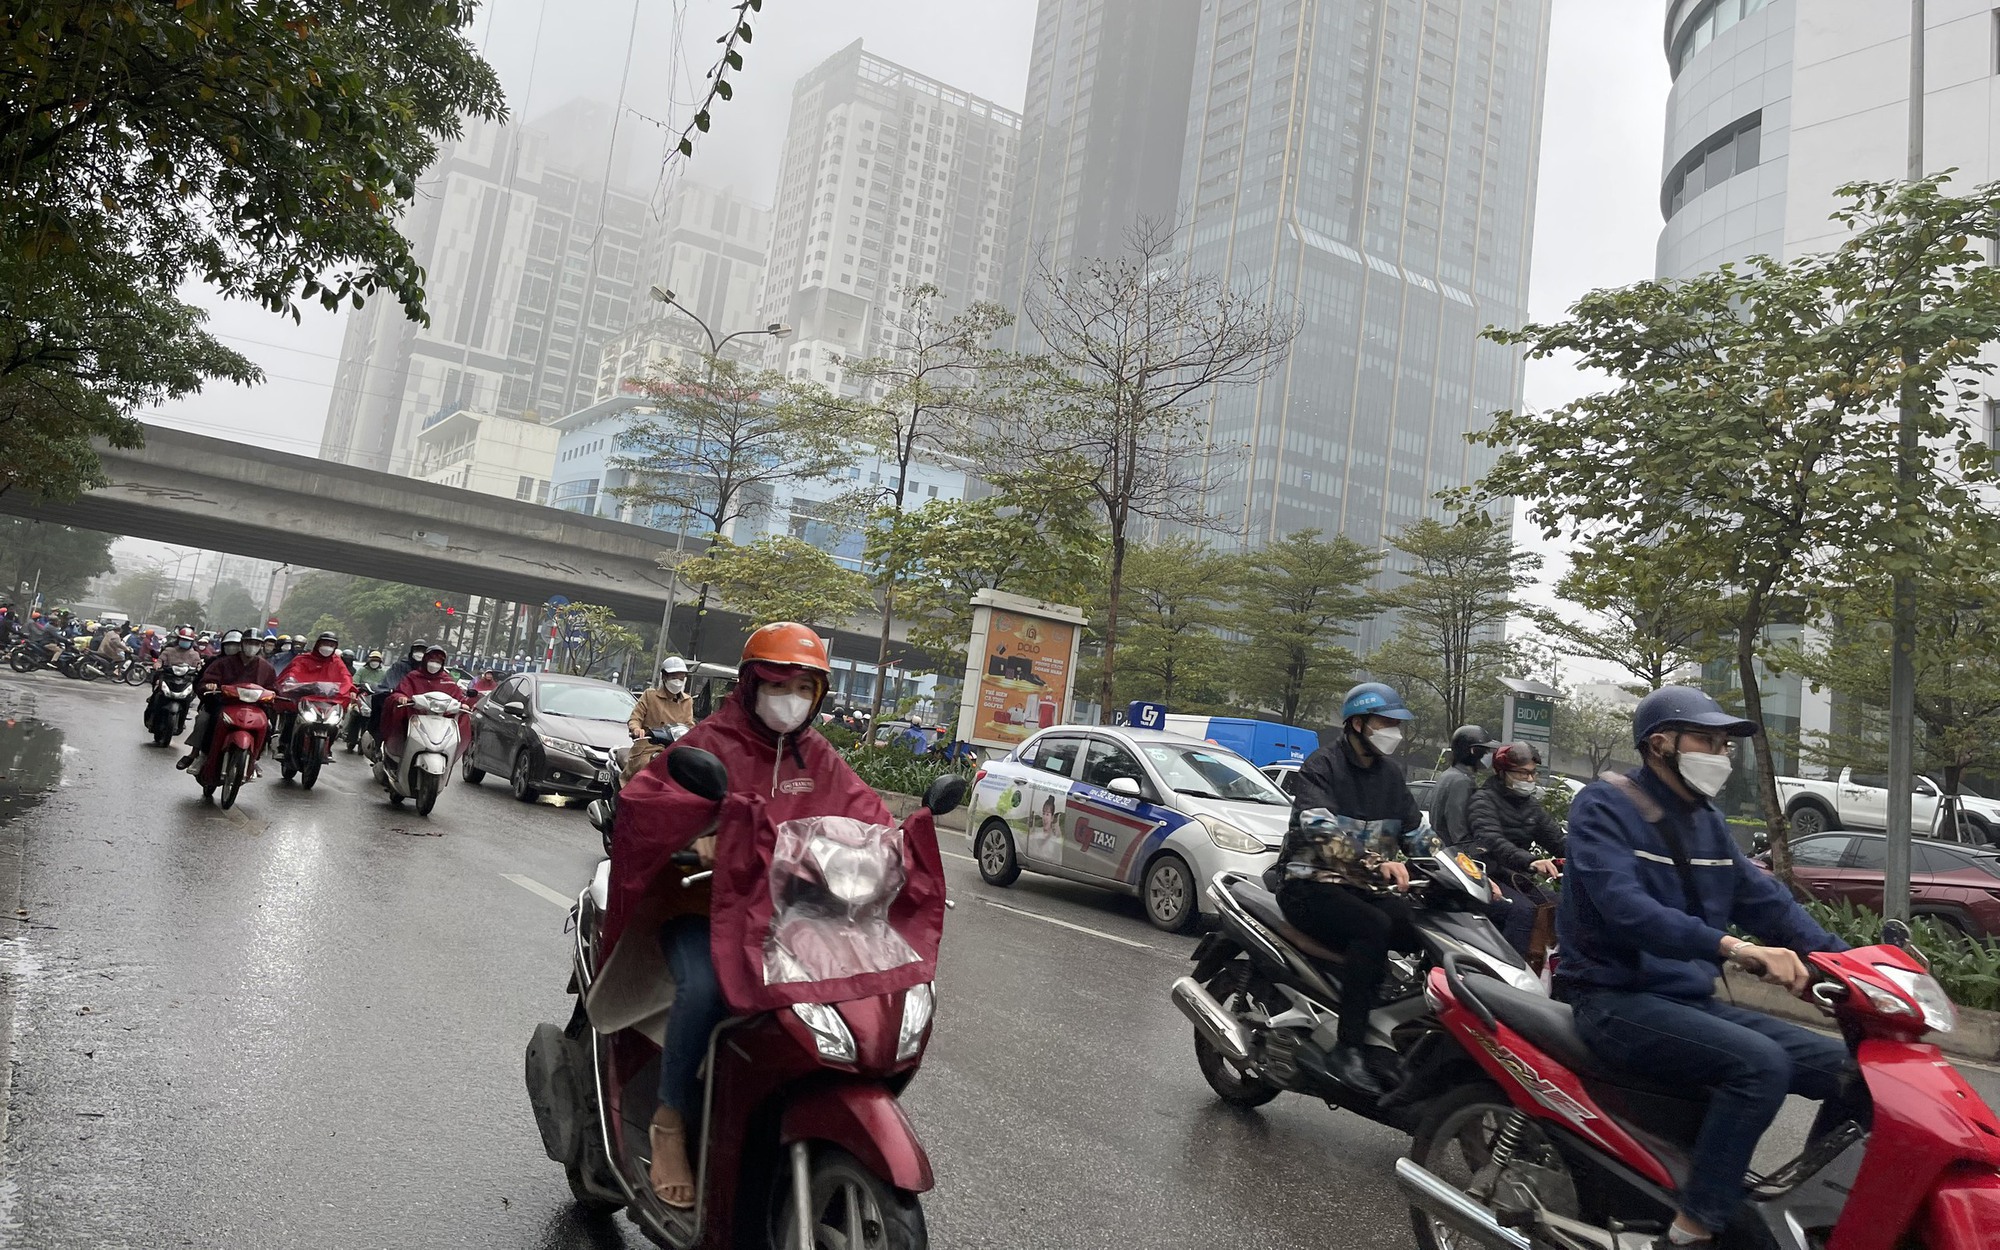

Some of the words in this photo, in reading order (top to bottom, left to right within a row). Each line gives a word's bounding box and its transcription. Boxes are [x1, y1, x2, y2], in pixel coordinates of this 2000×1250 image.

[1018, 642, 1040, 654] DOLO
[1354, 697, 1376, 706] UBER
[1142, 705, 1158, 726] G7
[1517, 707, 1539, 720] BIDV
[1094, 830, 1116, 848] TAXI
